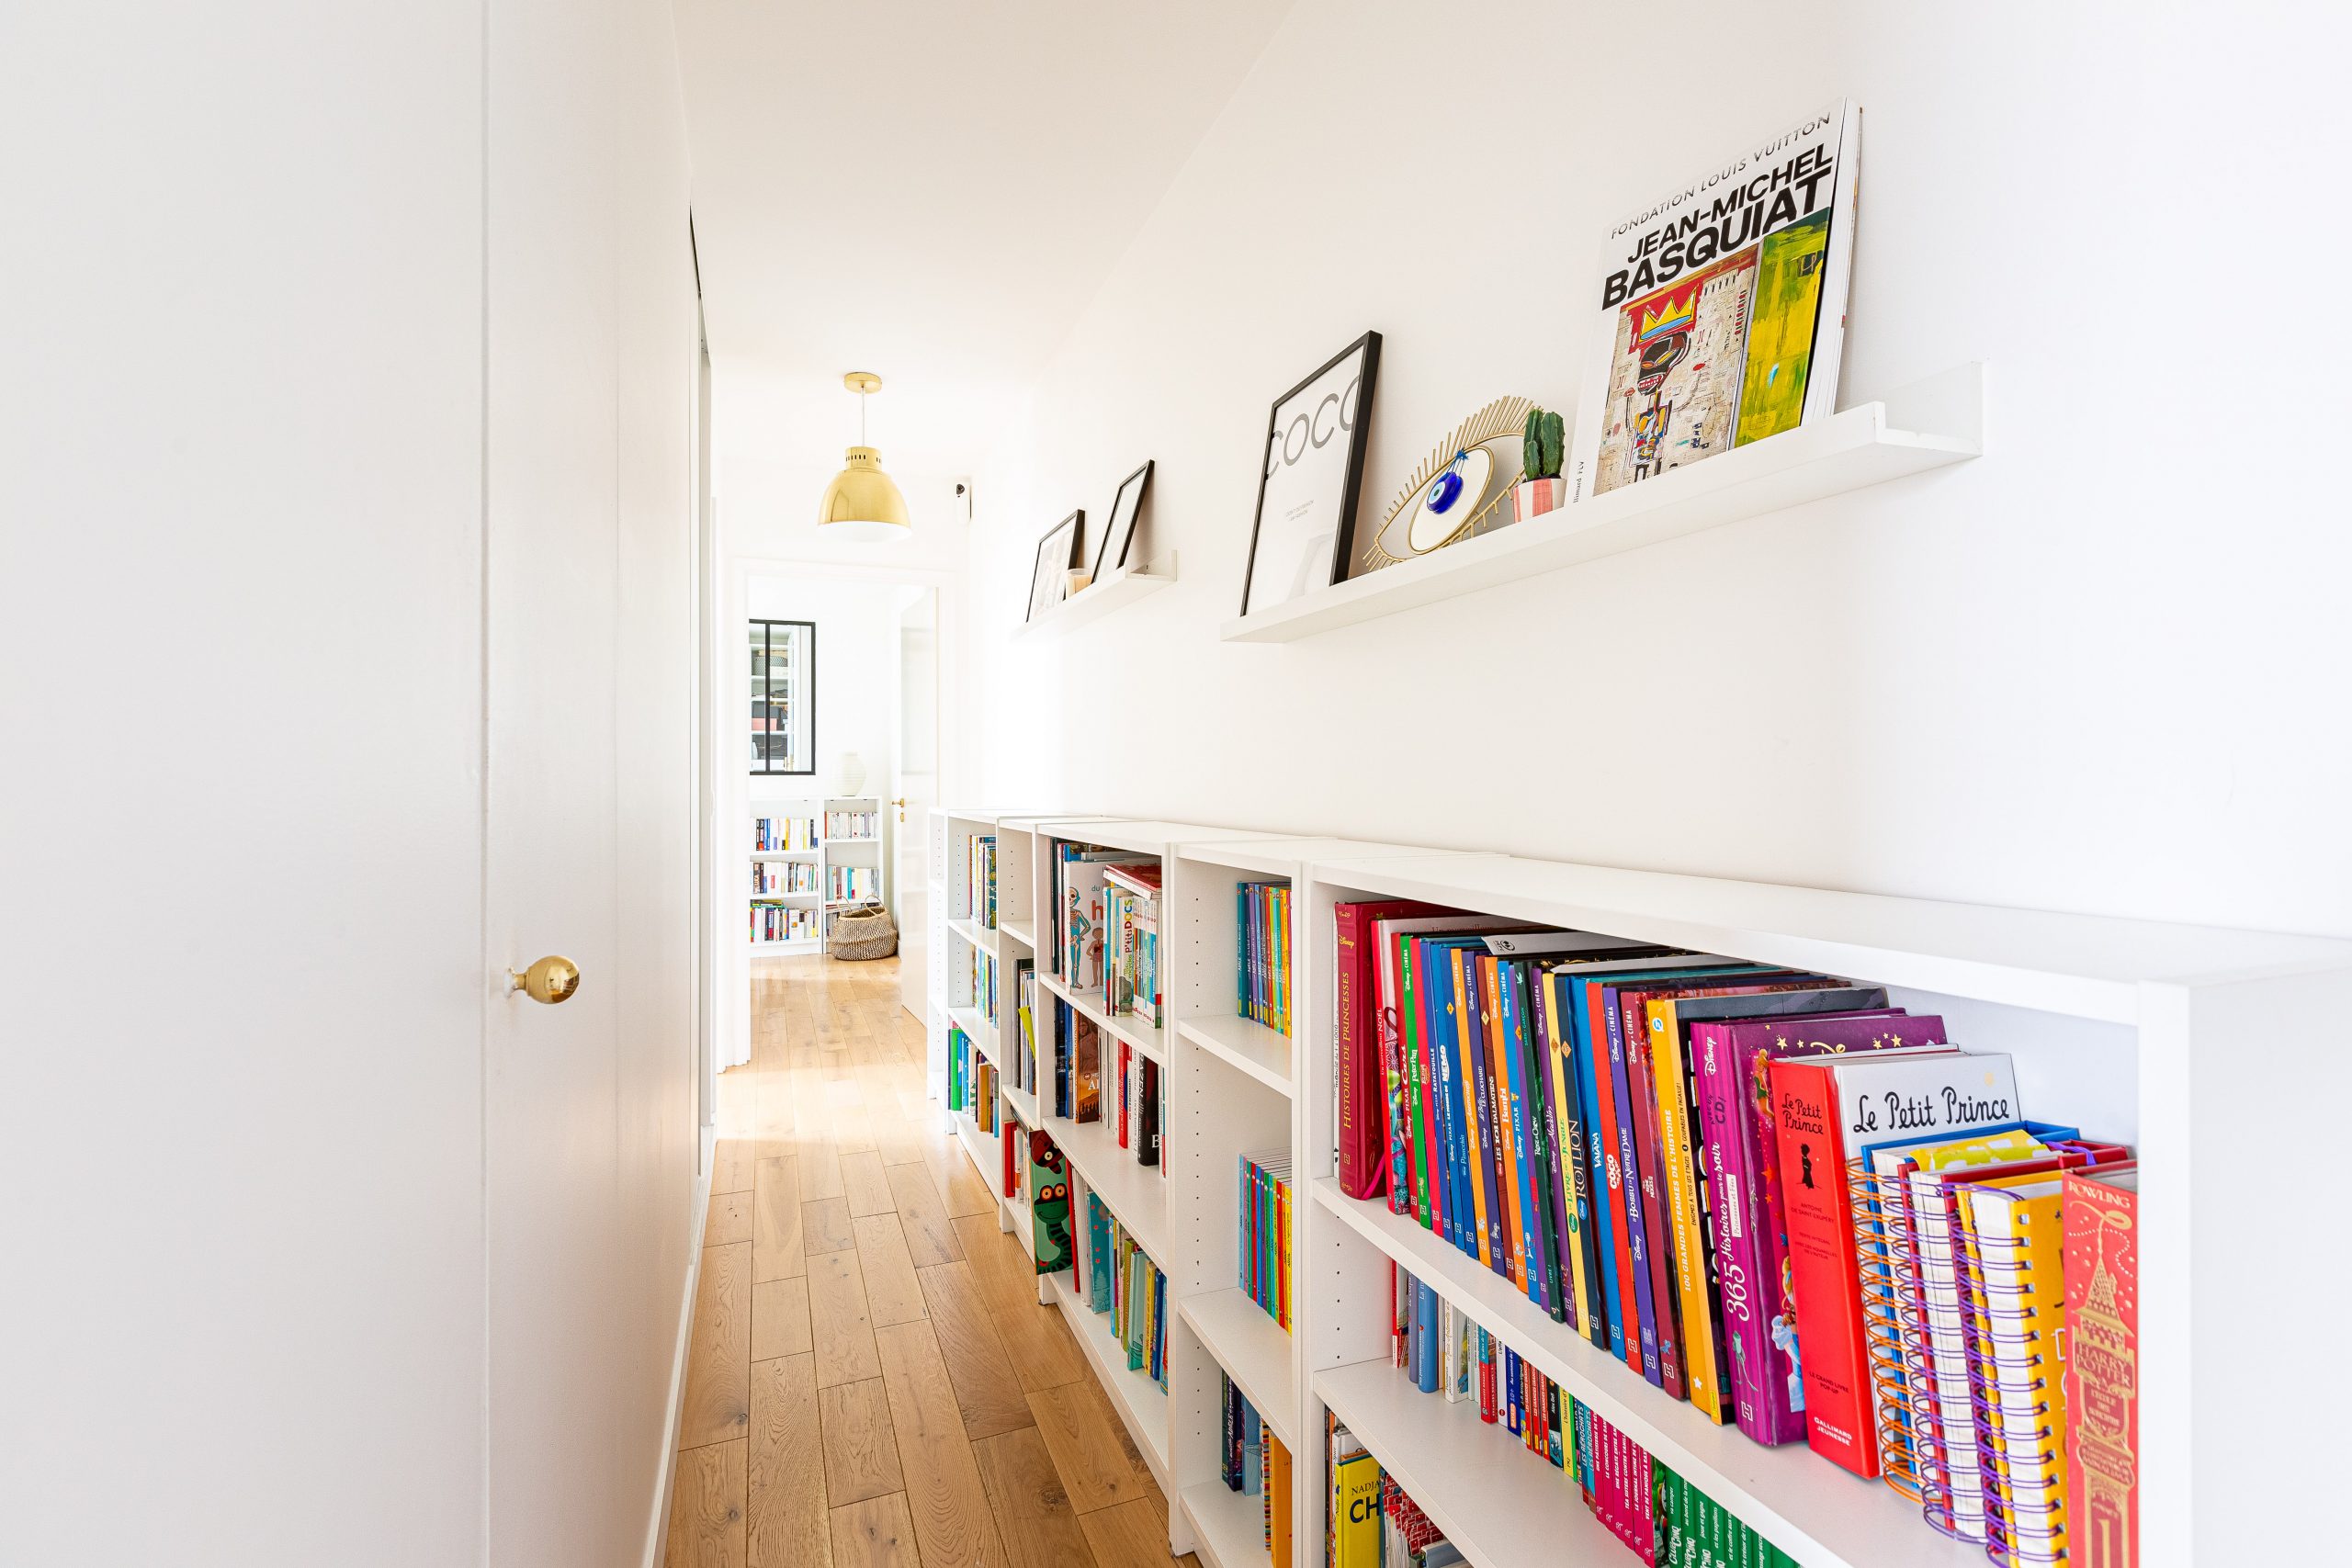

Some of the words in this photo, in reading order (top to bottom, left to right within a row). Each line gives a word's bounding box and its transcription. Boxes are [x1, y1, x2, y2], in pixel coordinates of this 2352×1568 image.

[1611, 186, 1695, 239] FONDATION
[1701, 158, 1747, 192] LOUIS
[1753, 112, 1831, 162] VUITTON
[1627, 142, 1834, 264] JEAN-MICHEL
[1601, 164, 1832, 311] BASQUIAT
[1572, 478, 1582, 503] llimard
[1124, 899, 1133, 930] DOCS
[1342, 972, 1351, 1042] PRINCESSES
[1343, 1043, 1351, 1061] DE
[1611, 1036, 1620, 1065] Disney
[1630, 1041, 1638, 1065] Disney
[1704, 1036, 1717, 1077] Disney
[1430, 1047, 1438, 1093] RATATOUILLE
[1477, 1066, 1487, 1099] CLOCHARD
[1342, 1064, 1351, 1129] HISTOIRES
[1488, 1076, 1499, 1123] DALMATIENS
[1499, 1088, 1510, 1123] Bambi
[1781, 1092, 1794, 1111] Le
[1794, 1098, 1823, 1120] Petit
[1853, 1094, 1879, 1133] Le
[1884, 1091, 1937, 1131] Petit
[1941, 1086, 2010, 1125] Prince
[1545, 1105, 1557, 1147] Aladdin
[1664, 1109, 1676, 1162] L'HISTOIRE
[1782, 1110, 1824, 1135] Prince
[1516, 1134, 1524, 1160] Disney
[1568, 1120, 1582, 1162] LION
[1592, 1132, 1602, 1168] VAIANA
[1710, 1141, 1724, 1176] soir
[1574, 1166, 1587, 1199] ROI
[1607, 1154, 1617, 1190] COCO
[1671, 1166, 1679, 1179] DE
[1673, 1179, 1683, 1223] FEMMES
[2067, 1180, 2132, 1210] ROWLING
[1634, 1235, 1643, 1261] Disney
[1678, 1224, 1690, 1272] GRANDES
[1719, 1203, 1735, 1261] Histoires
[1724, 1260, 1750, 1322] 365
[2075, 1354, 2132, 1388] POTTER
[2077, 1343, 2127, 1370] HARRY
[1577, 1405, 1587, 1453] AÉROCHATS
[1814, 1416, 1852, 1440] GALLIMARD
[1816, 1426, 1851, 1447] JEUNESSE
[1351, 1477, 1380, 1496] NADJA
[1671, 1526, 1682, 1548] CINQ
[1686, 1537, 1697, 1559] CINQ
